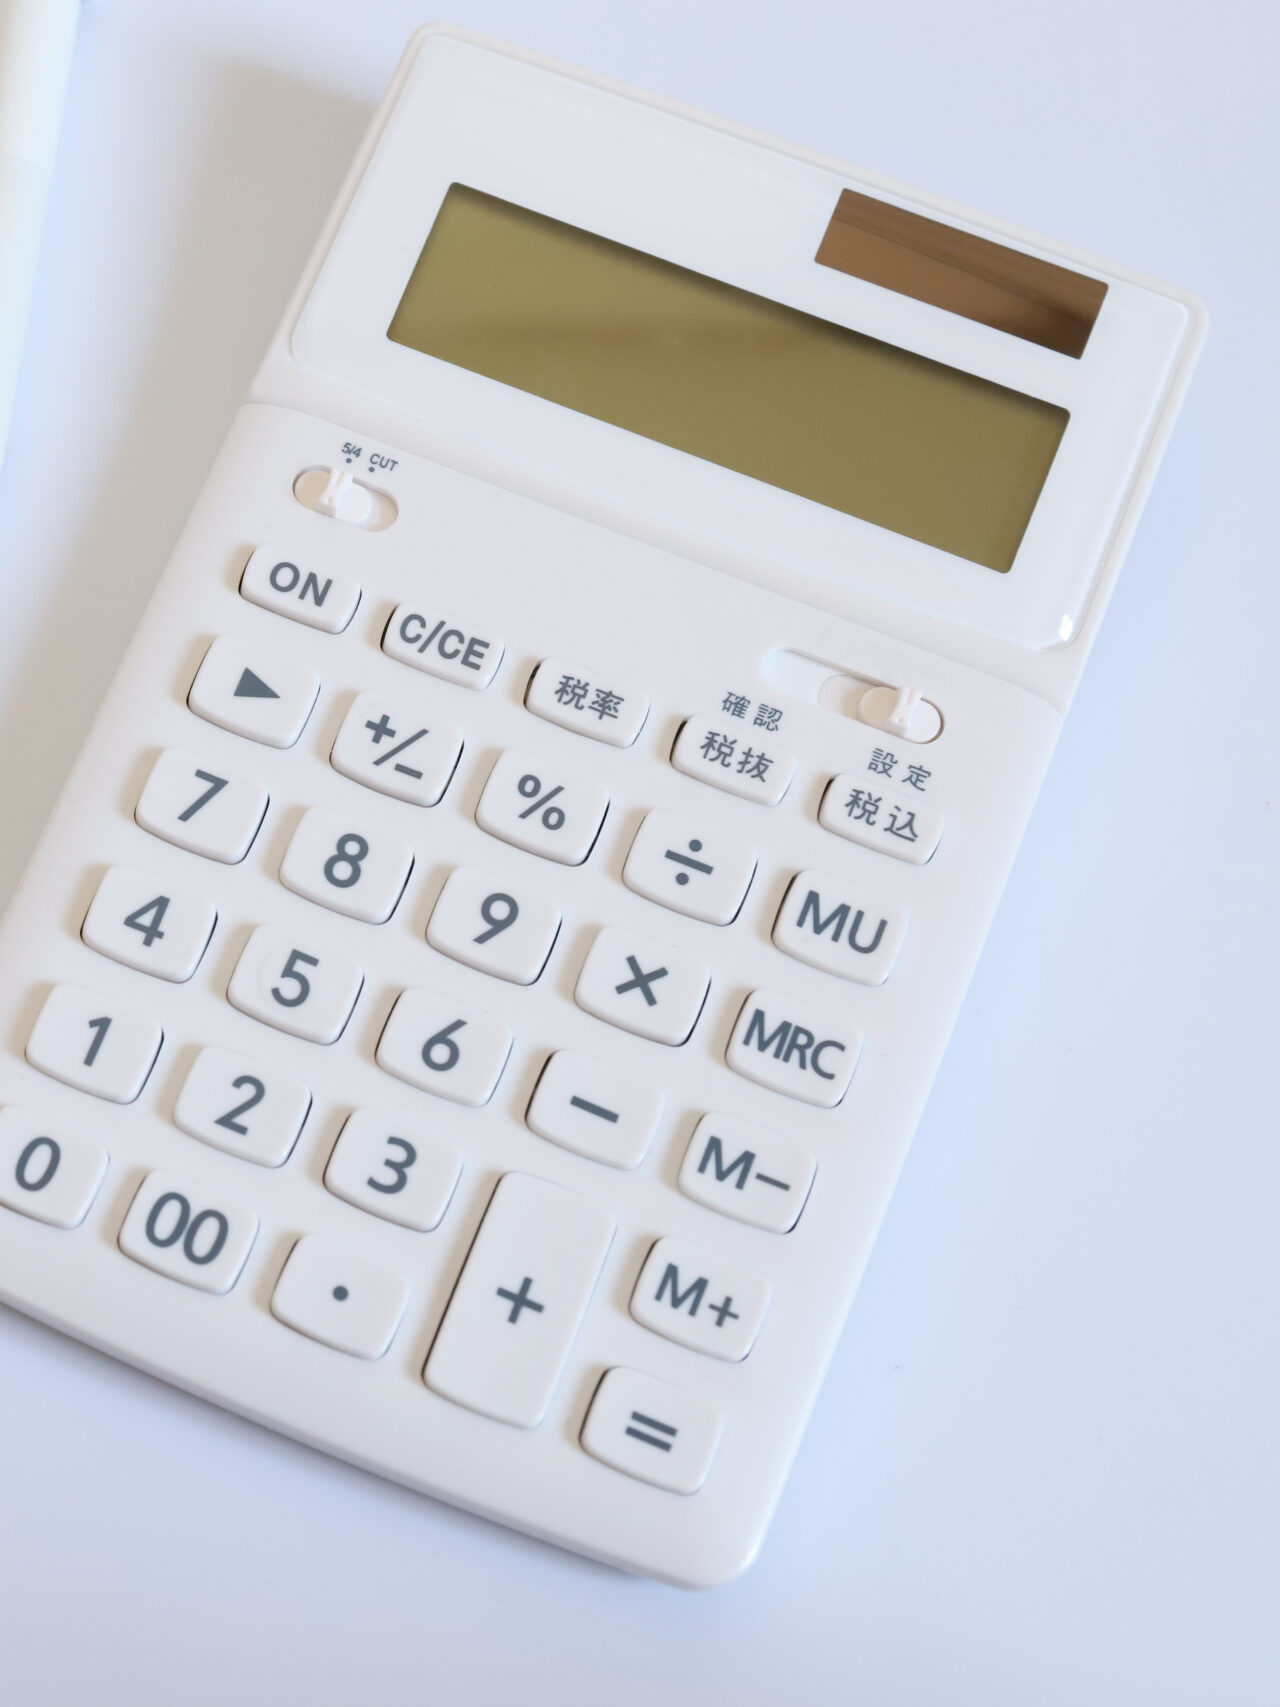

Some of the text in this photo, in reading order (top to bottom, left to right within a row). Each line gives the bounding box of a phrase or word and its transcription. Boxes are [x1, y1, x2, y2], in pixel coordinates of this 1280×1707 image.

[341, 442, 399, 472] 5/4 CUT
[270, 562, 332, 608] ON
[400, 614, 490, 670] C/CE
[554, 675, 625, 721] 税率
[721, 691, 782, 732] 確認
[699, 731, 774, 783] 税抜
[870, 746, 932, 792] 設定
[178, 770, 228, 823] 7
[518, 775, 565, 831] %
[844, 788, 919, 843] 税込
[324, 834, 368, 889] 8
[124, 896, 170, 948] 4
[473, 893, 518, 945] 9
[797, 889, 887, 954] MU
[271, 949, 319, 1008] 5
[84, 1016, 112, 1067] 1
[422, 1020, 467, 1071] 6
[743, 1009, 845, 1081] MRC
[215, 1075, 265, 1136] 2
[15, 1137, 61, 1193] 0
[367, 1137, 416, 1195] 3
[146, 1192, 228, 1266] 00
[655, 1263, 739, 1328] M+
